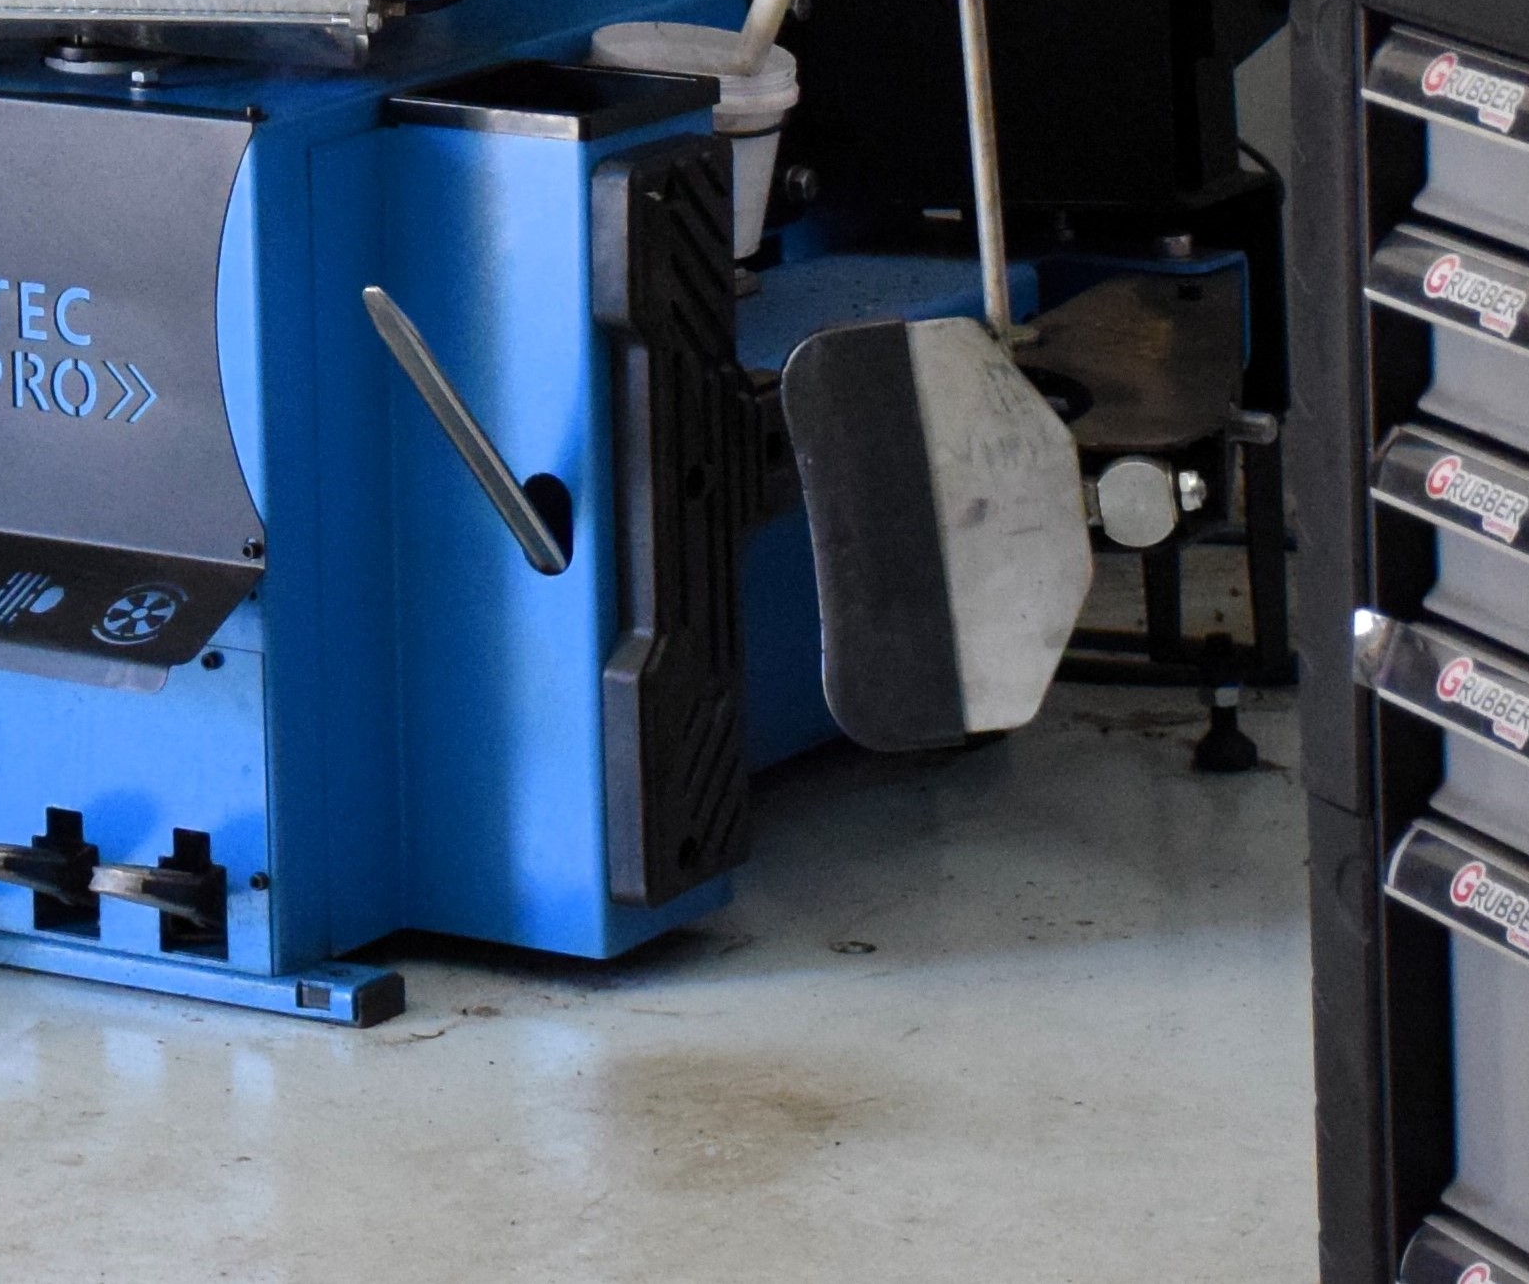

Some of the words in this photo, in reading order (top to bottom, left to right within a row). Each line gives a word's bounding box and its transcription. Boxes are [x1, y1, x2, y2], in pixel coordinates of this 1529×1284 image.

[1423, 53, 1523, 115] GRUBBER
[1425, 255, 1525, 319] GRUBBER
[1427, 458, 1527, 525] GRUBBER
